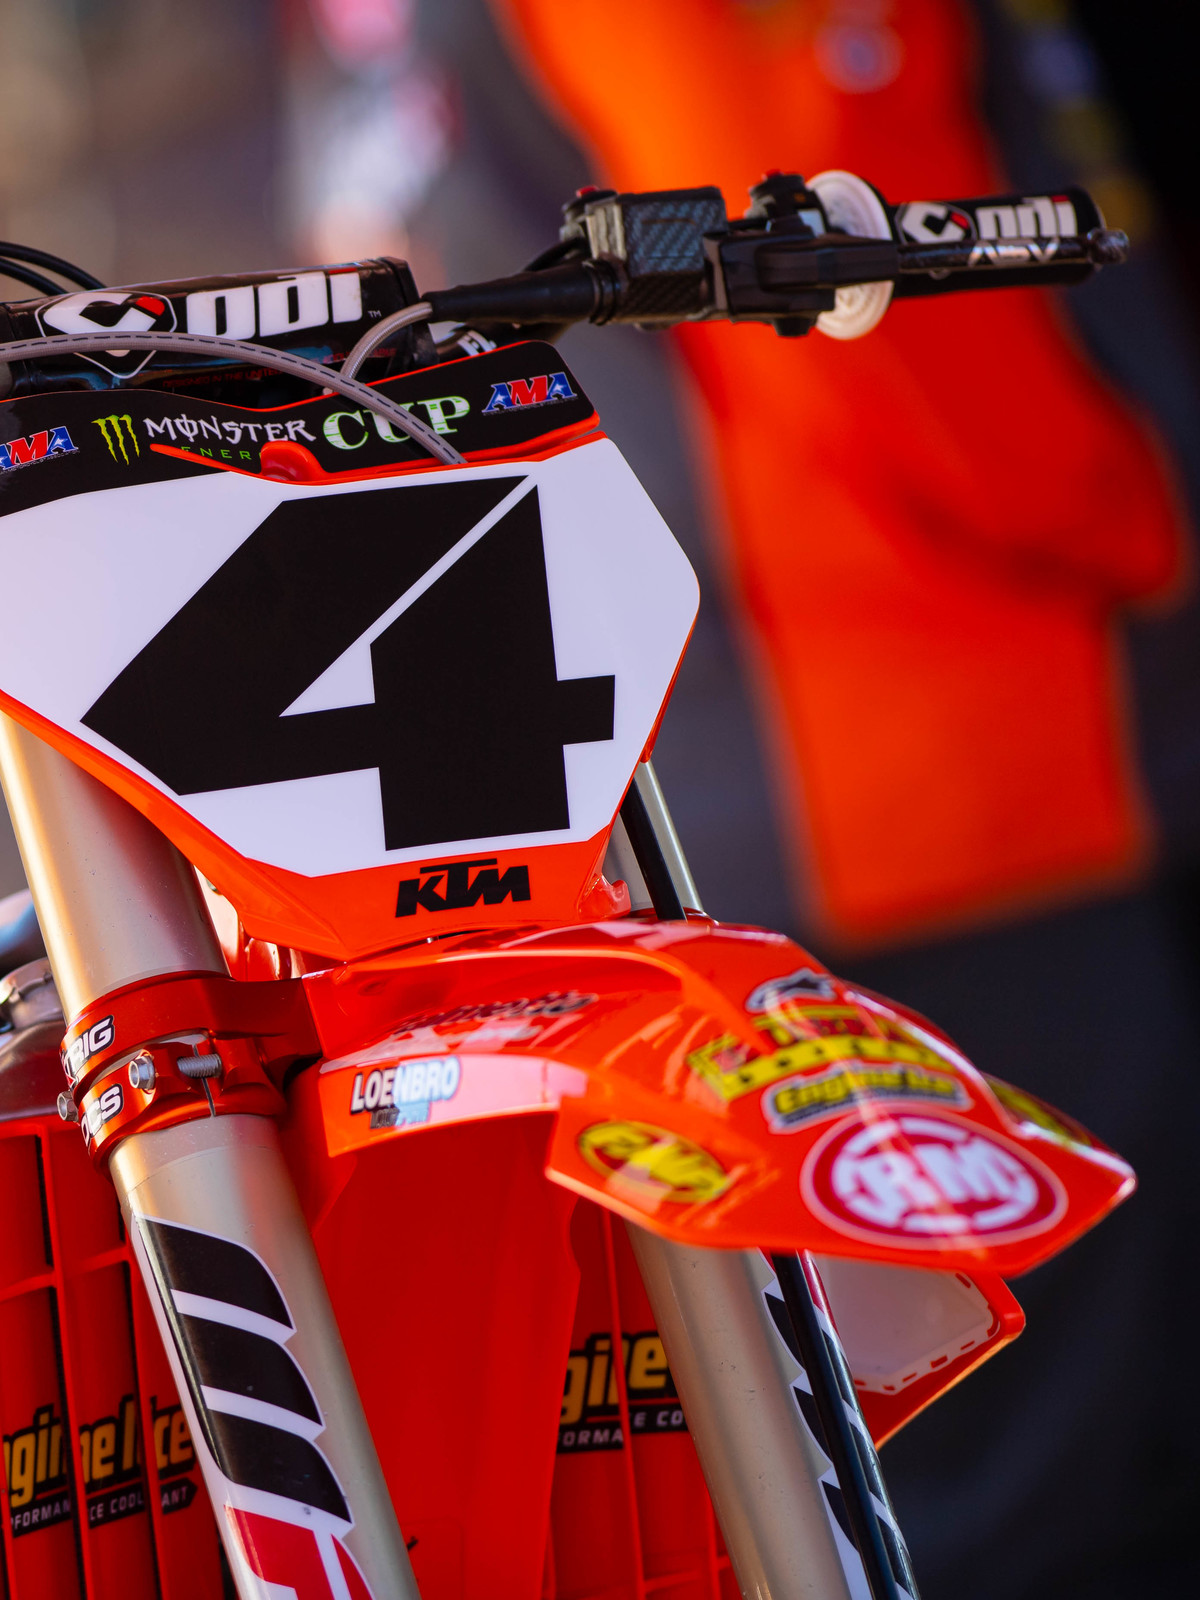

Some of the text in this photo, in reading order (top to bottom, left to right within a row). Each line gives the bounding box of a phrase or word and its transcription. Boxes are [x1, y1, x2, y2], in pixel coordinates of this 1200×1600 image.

[481, 371, 578, 413] AMA
[322, 396, 470, 450] CUP
[80, 475, 616, 851] 4
[395, 858, 531, 918] KTM
[351, 1056, 461, 1115] LOENBRO
